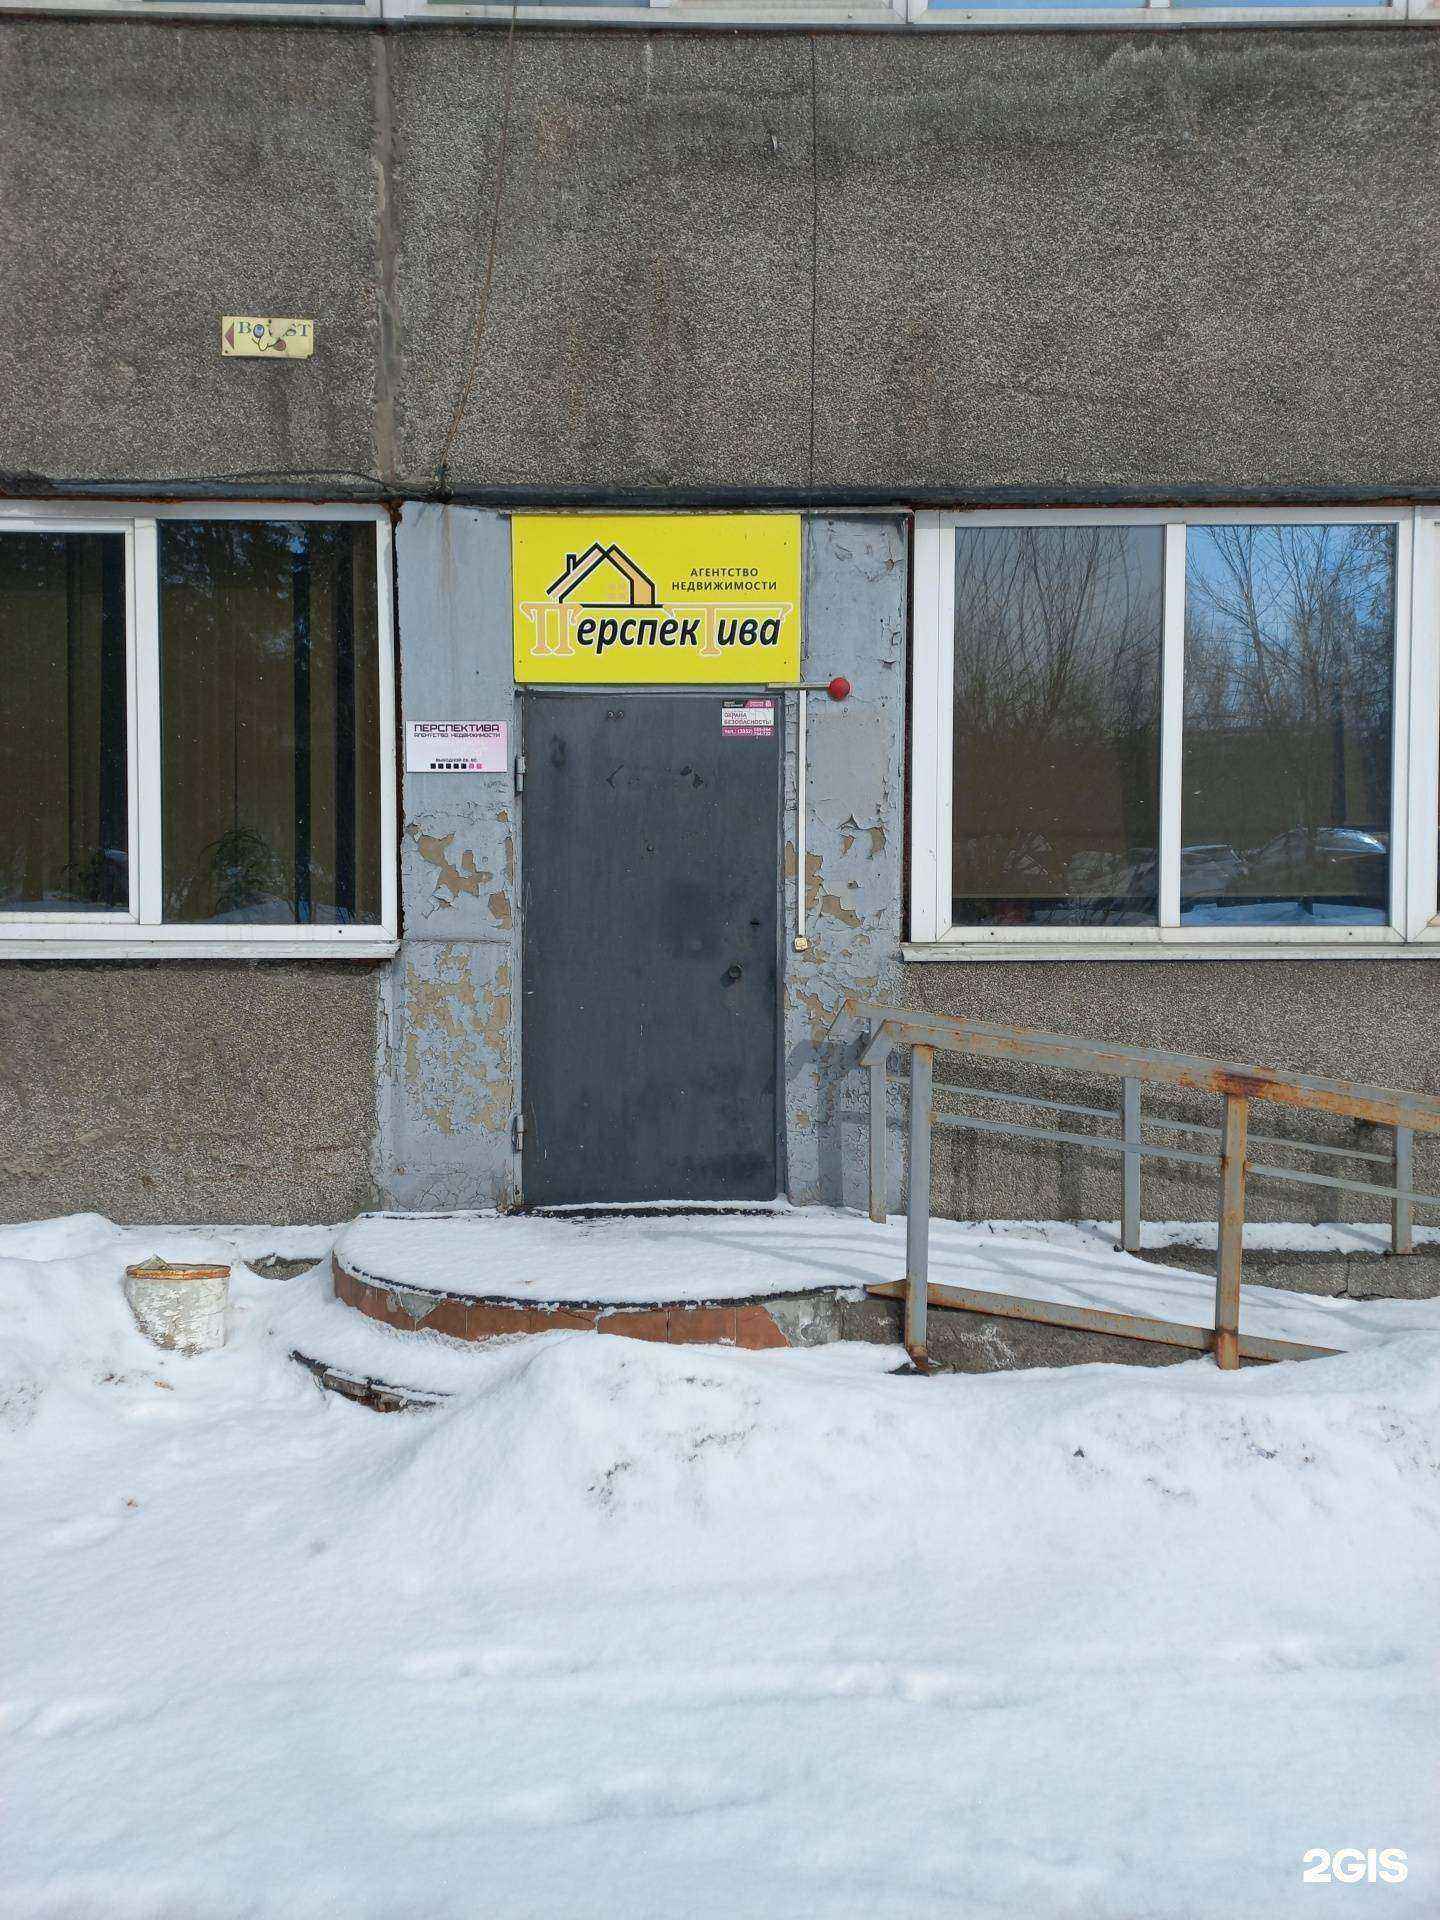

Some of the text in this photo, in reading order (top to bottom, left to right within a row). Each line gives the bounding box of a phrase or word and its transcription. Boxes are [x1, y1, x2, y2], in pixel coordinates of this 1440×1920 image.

[690, 567, 759, 577] АГЕНТСТВО
[671, 581, 777, 592] НЕДВИЖИМОСТИ
[414, 724, 500, 732] ПЕРСПЕКТИВА
